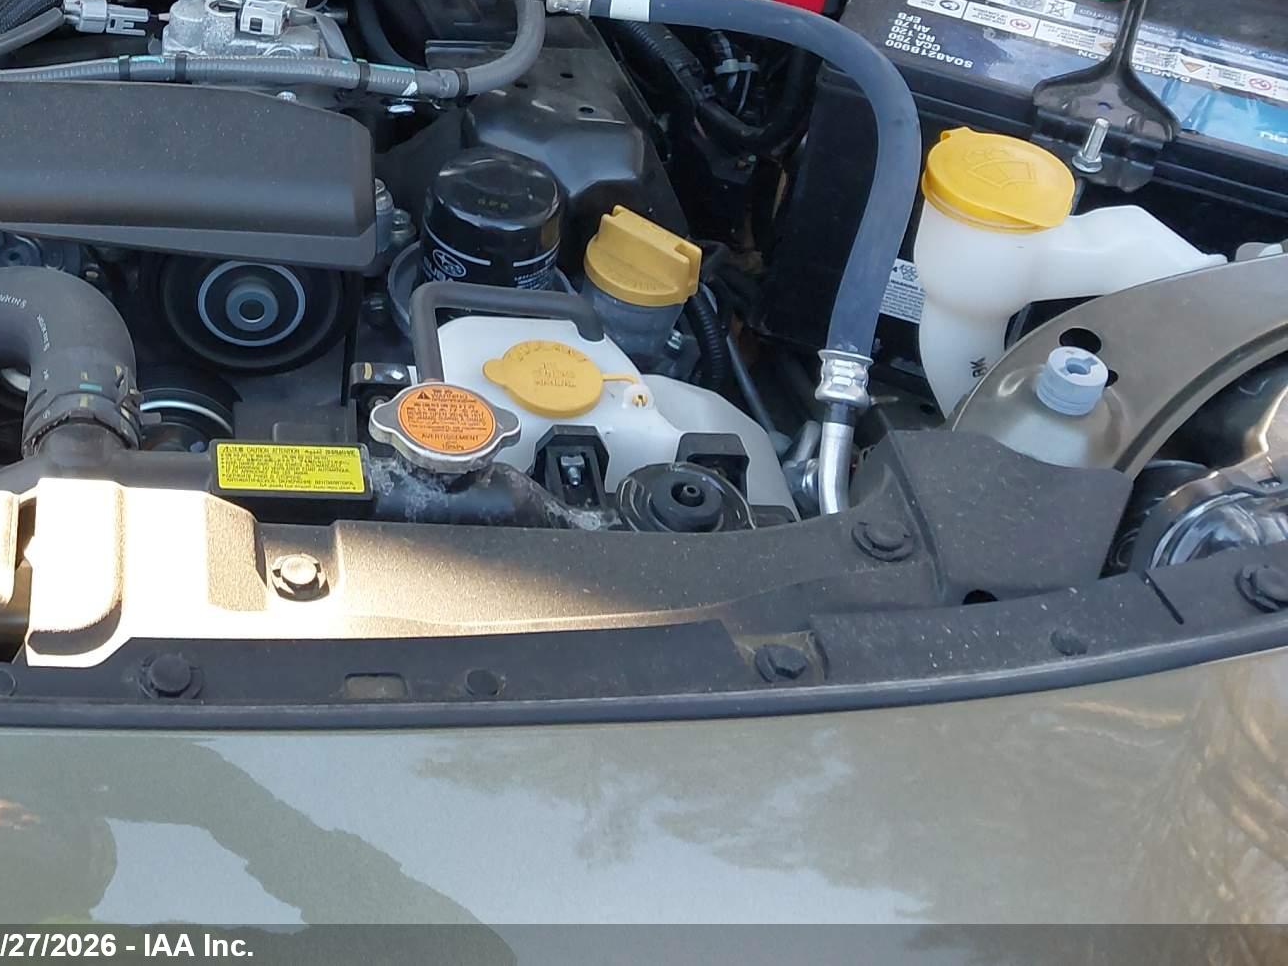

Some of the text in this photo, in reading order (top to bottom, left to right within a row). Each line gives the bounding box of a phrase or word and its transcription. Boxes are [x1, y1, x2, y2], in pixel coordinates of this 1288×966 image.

[891, 25, 936, 44] RC 120
[913, 22, 932, 34] Ah
[914, 39, 942, 52] CCA
